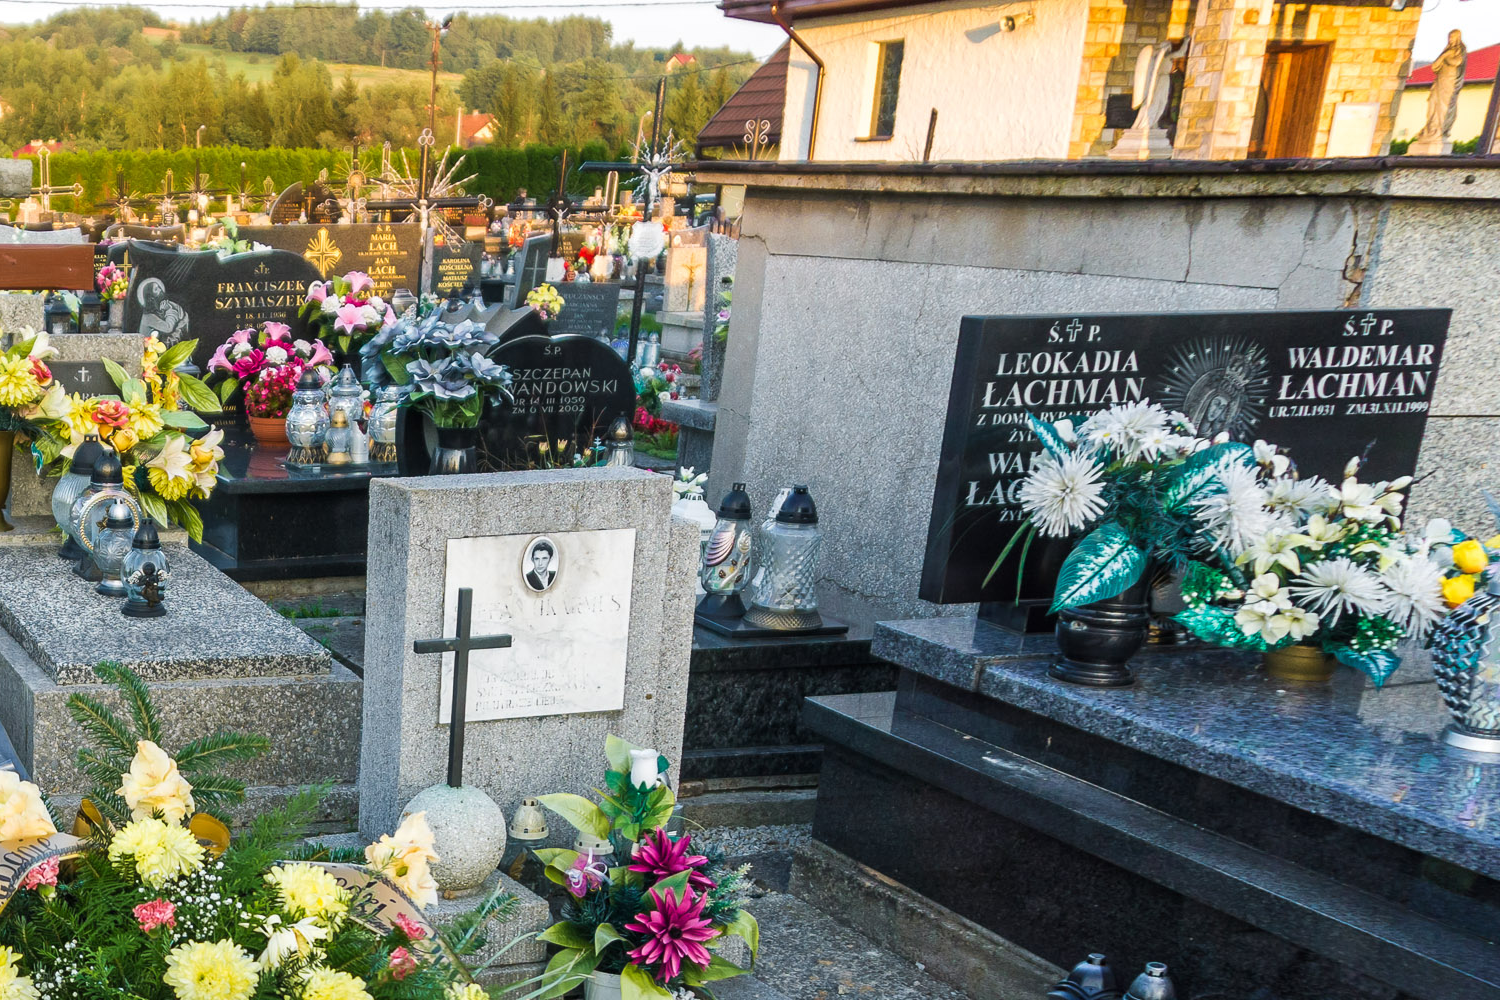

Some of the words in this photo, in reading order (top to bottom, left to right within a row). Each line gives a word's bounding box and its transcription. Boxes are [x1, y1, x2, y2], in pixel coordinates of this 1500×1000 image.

[369, 242, 398, 251] LACH
[374, 256, 390, 264] JAN
[368, 266, 396, 274] LACH
[217, 280, 306, 293] FRANCISZEK
[214, 294, 306, 310] SZYMASZEK
[1048, 320, 1064, 344] Ś.
[1088, 325, 1102, 342] P.
[1342, 316, 1357, 336] Ś.
[1380, 320, 1394, 336] P.
[996, 350, 1139, 376] LEOKADIA
[1287, 344, 1435, 369] WALDEMAR
[512, 368, 592, 380] SZCZEPAN
[982, 376, 1146, 408] ŁACHMAN
[1278, 371, 1432, 400] ŁACHMAN
[512, 398, 526, 406] UR
[560, 396, 586, 404] 1959
[512, 406, 525, 414] ZM
[558, 404, 585, 412] 2002
[976, 414, 987, 426] Z
